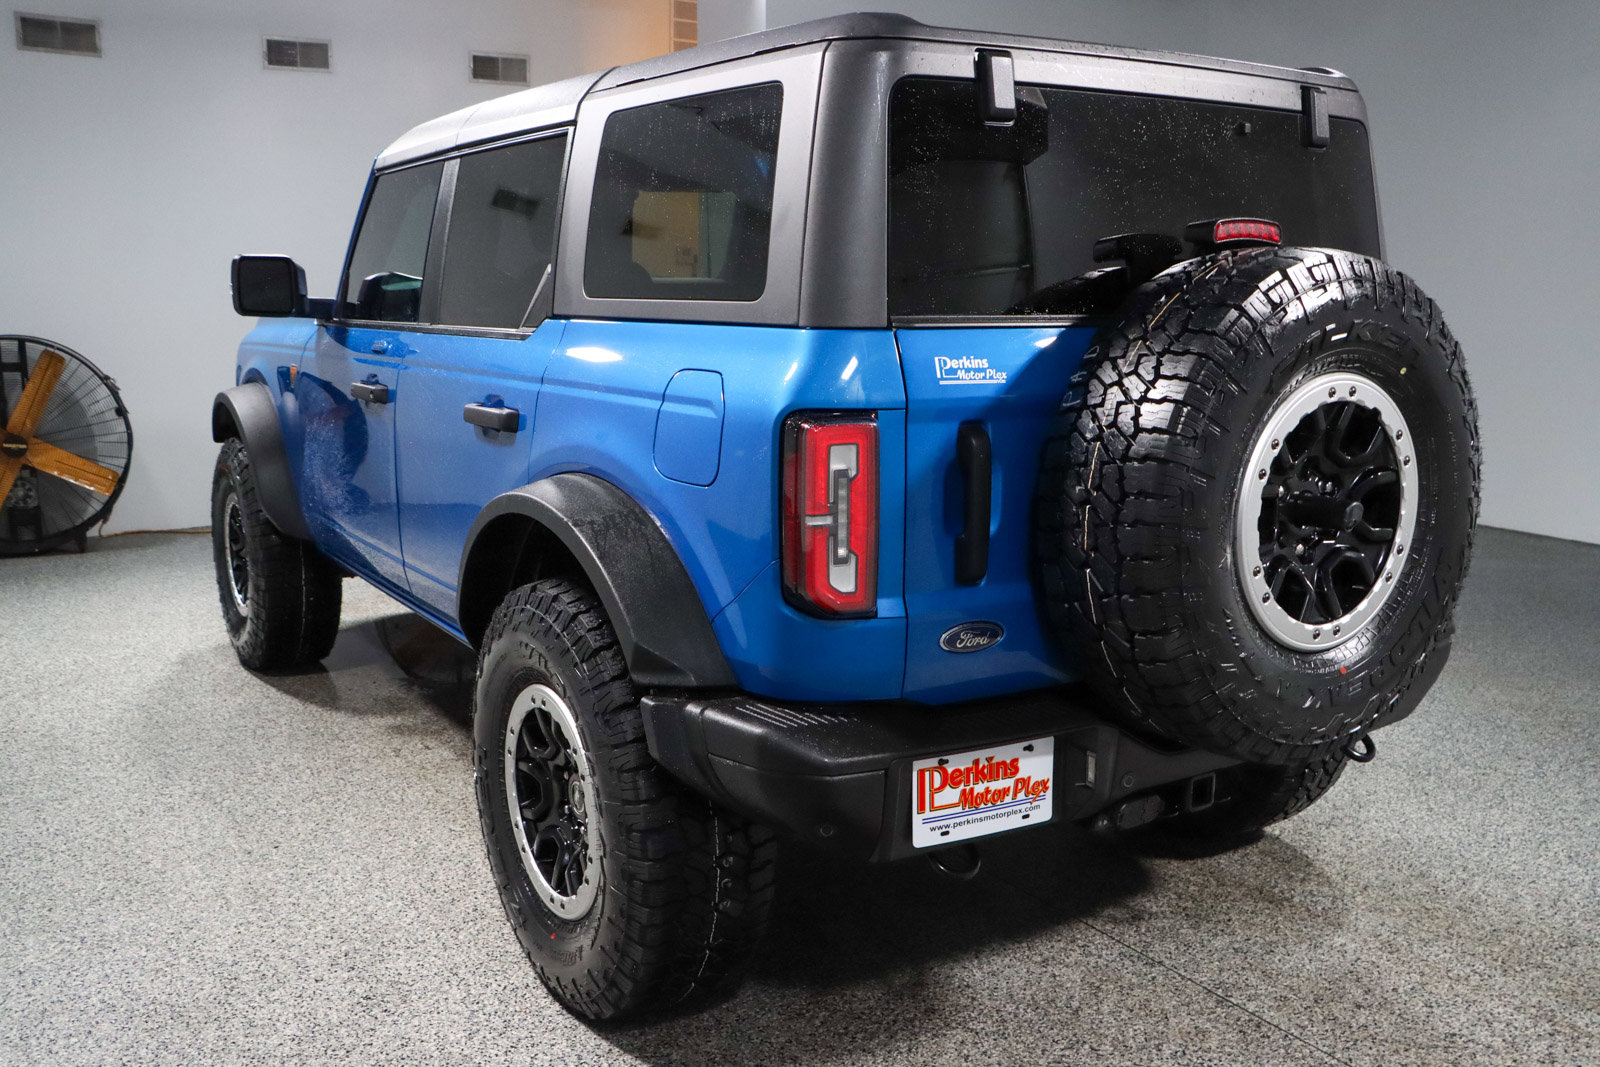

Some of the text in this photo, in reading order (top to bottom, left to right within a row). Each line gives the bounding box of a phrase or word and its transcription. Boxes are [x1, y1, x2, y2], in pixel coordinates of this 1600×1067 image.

[934, 355, 989, 379] Perkins
[957, 368, 1008, 382] Motor Plex
[956, 630, 991, 648] Ford
[917, 755, 1020, 814] Perkins
[958, 775, 1050, 810] Motor Plex
[929, 803, 1041, 832] www.perkinsmotorplex.com
